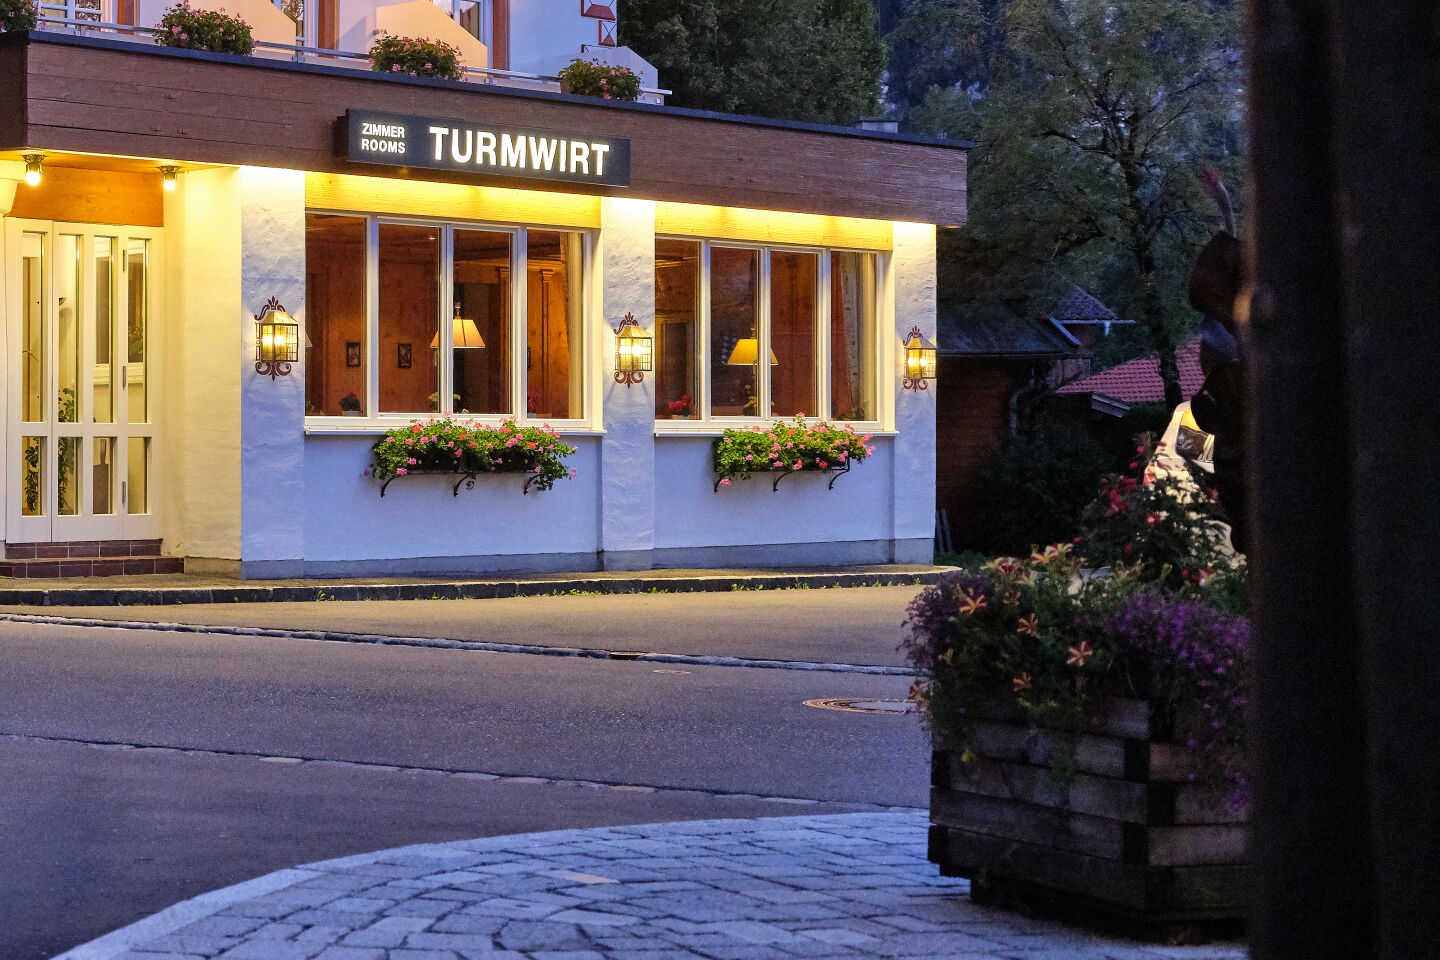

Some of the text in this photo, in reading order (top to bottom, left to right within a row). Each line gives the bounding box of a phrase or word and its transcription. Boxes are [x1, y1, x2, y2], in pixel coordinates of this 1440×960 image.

[361, 122, 405, 139] ZIMMER
[361, 138, 406, 154] ROOMS
[429, 126, 610, 176] TURMWIRT
